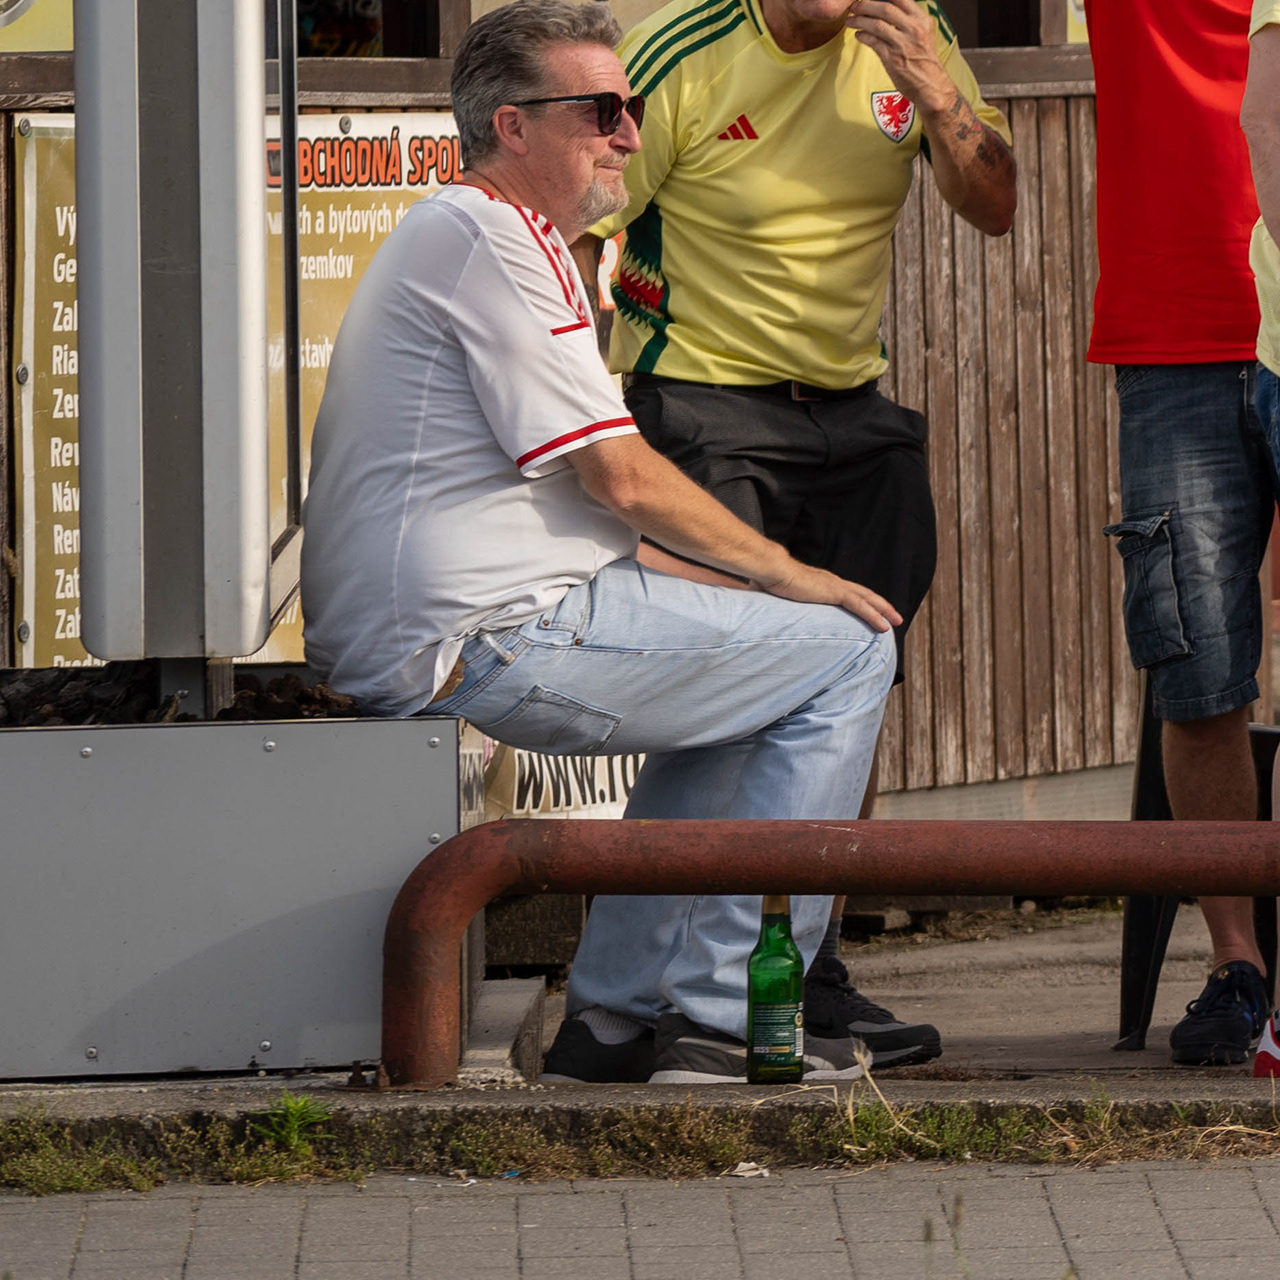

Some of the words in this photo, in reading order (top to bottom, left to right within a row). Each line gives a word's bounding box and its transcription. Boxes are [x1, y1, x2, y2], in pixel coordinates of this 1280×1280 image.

[298, 125, 402, 187] BCHODNÁ
[328, 202, 391, 243] bytových
[300, 248, 354, 280] zemkov
